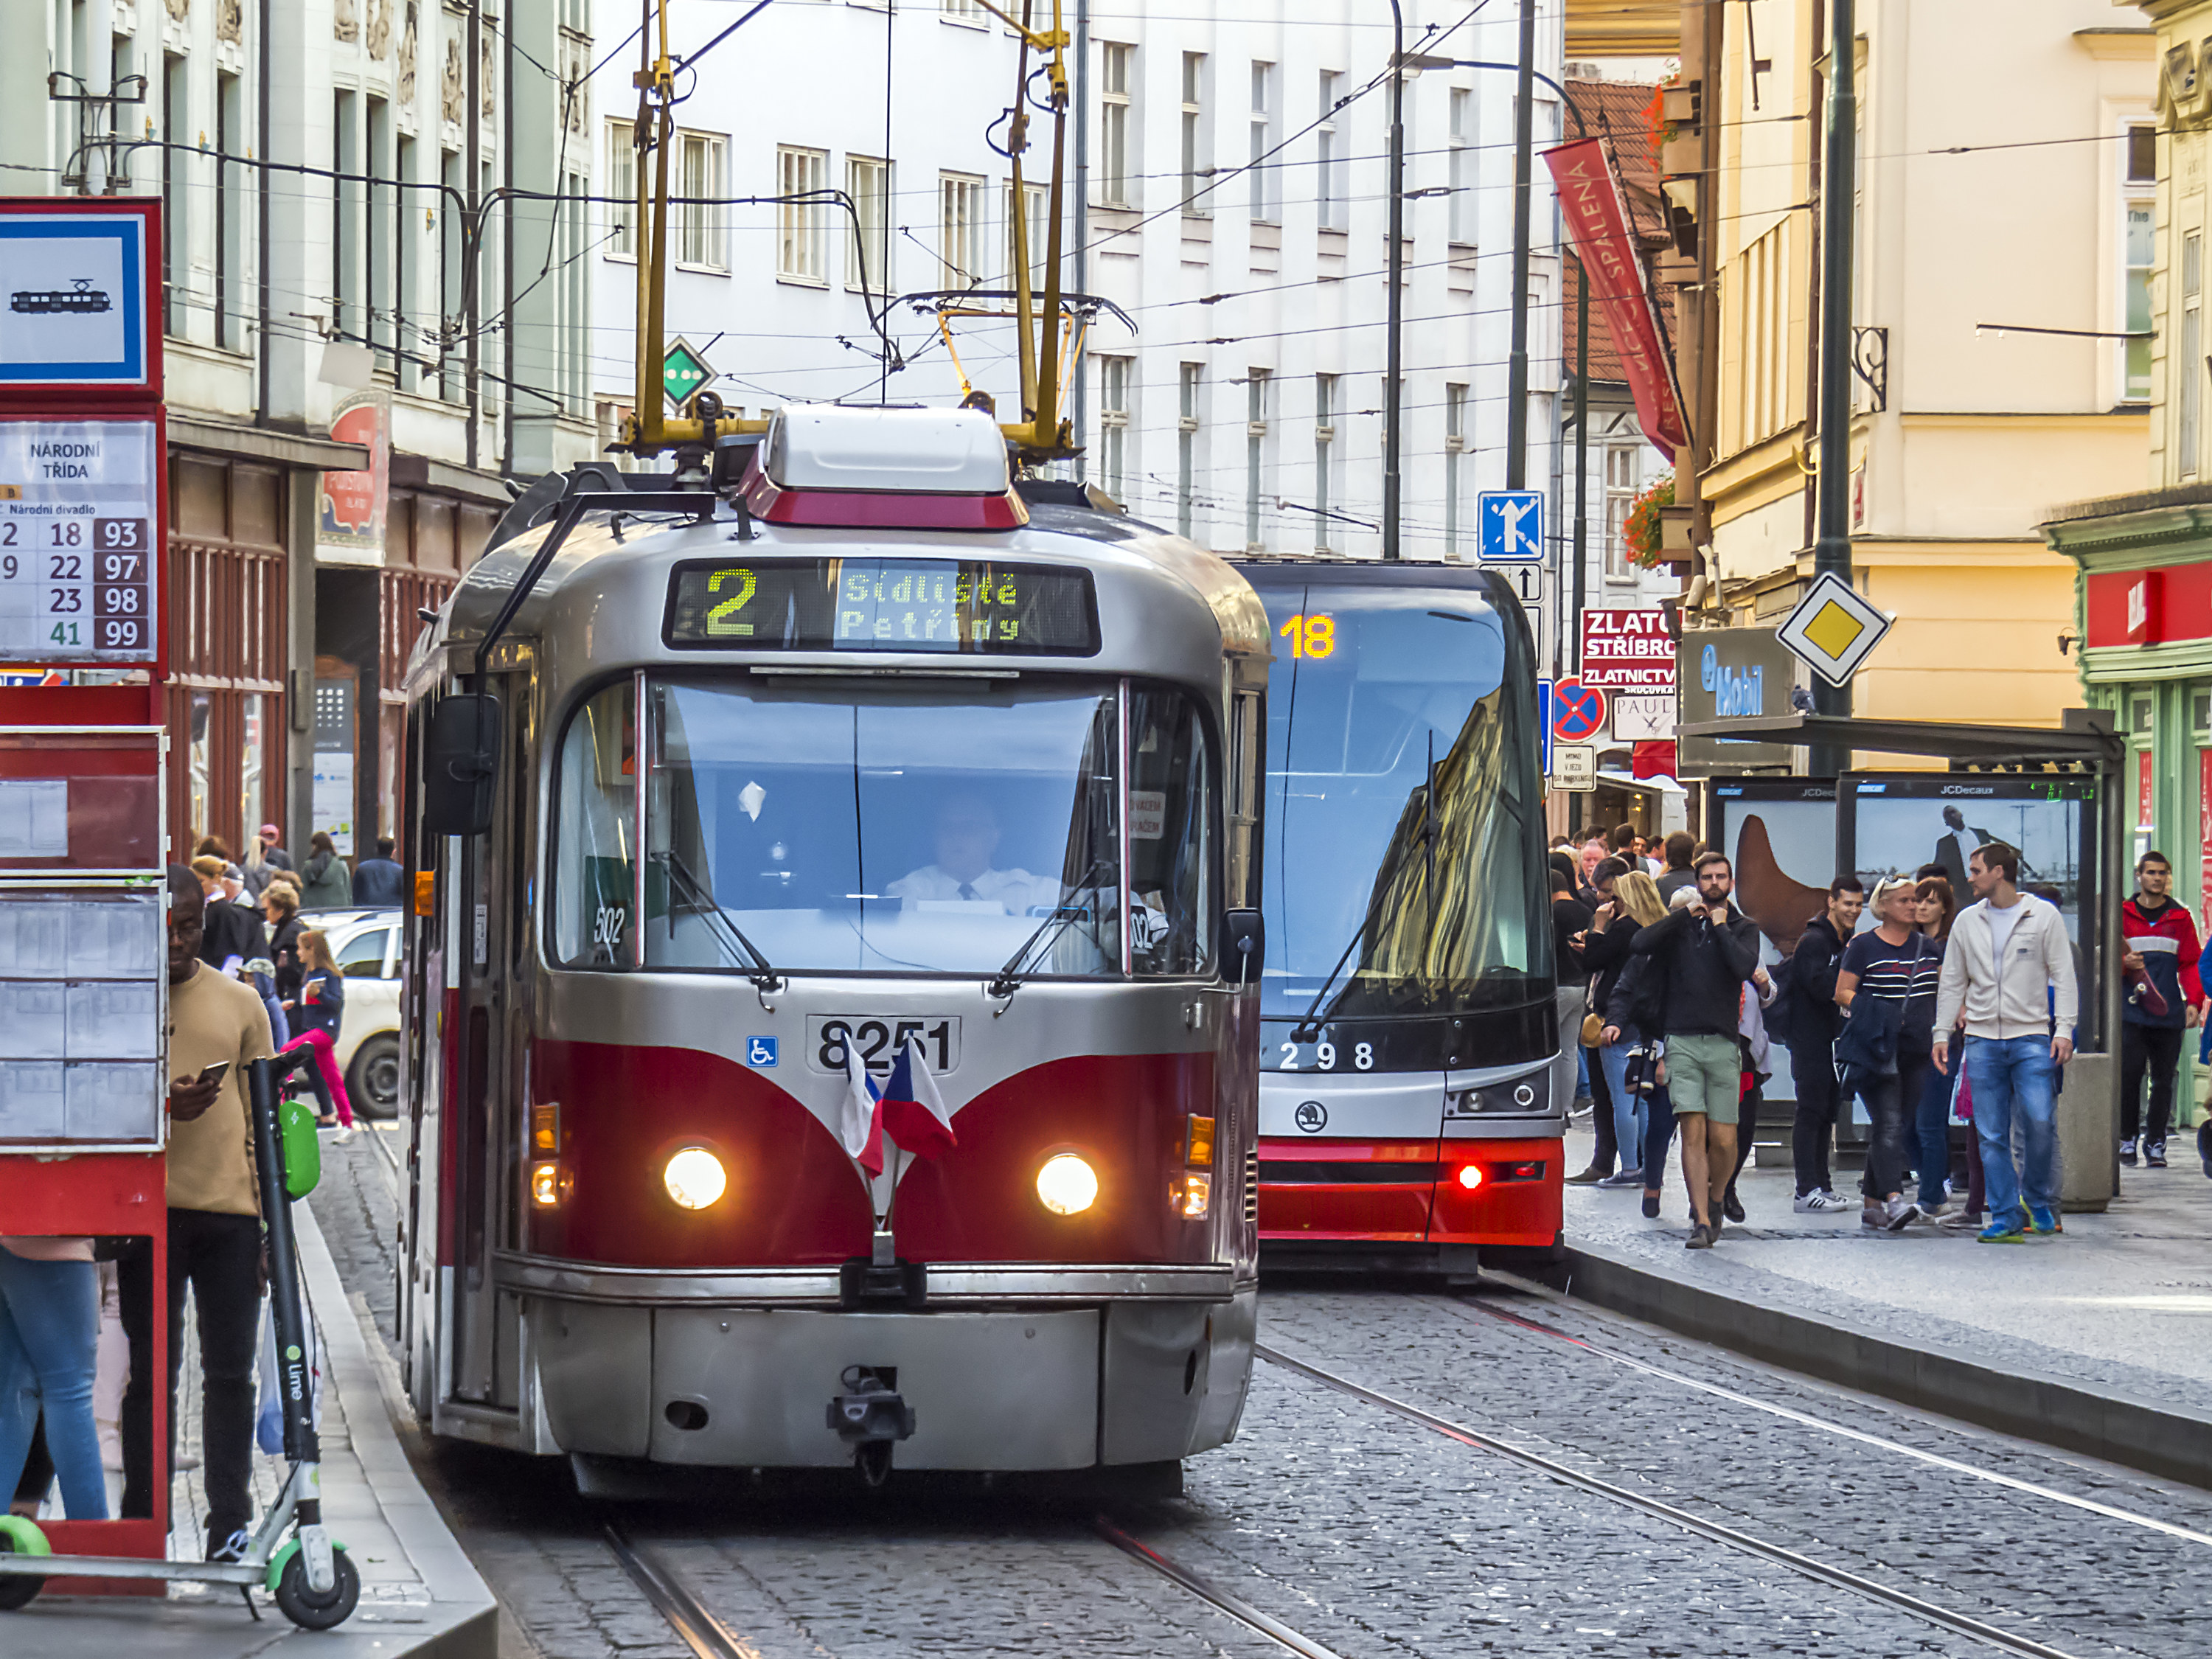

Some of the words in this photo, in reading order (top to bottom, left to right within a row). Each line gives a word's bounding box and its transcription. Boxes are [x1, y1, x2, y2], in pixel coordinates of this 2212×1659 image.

[31, 442, 100, 457] NÁRODNÍ
[43, 462, 88, 478] TŘÍDA
[10, 504, 52, 515] Národní
[56, 504, 96, 515] divadlo
[3, 522, 18, 546] 2
[51, 523, 82, 546] 18
[105, 522, 137, 547] 93
[3, 555, 18, 580] 9
[50, 555, 81, 579] 22
[105, 555, 138, 580] 97
[50, 588, 82, 613] 23
[105, 588, 139, 613] 98
[846, 571, 1018, 605] Sídliště
[707, 568, 757, 636] 2
[50, 622, 81, 645] 41
[105, 621, 139, 646] 99
[1280, 615, 1336, 658] 18
[1584, 669, 1675, 683] ZLATNICTV
[1617, 699, 1671, 714] PAUL
[1802, 788, 1837, 797] JCDec
[1941, 785, 1994, 795] JCDecaux
[594, 907, 625, 944] 502
[1130, 913, 1153, 950] 02
[818, 1020, 950, 1070] 8251
[288, 1363, 303, 1401] Lime
